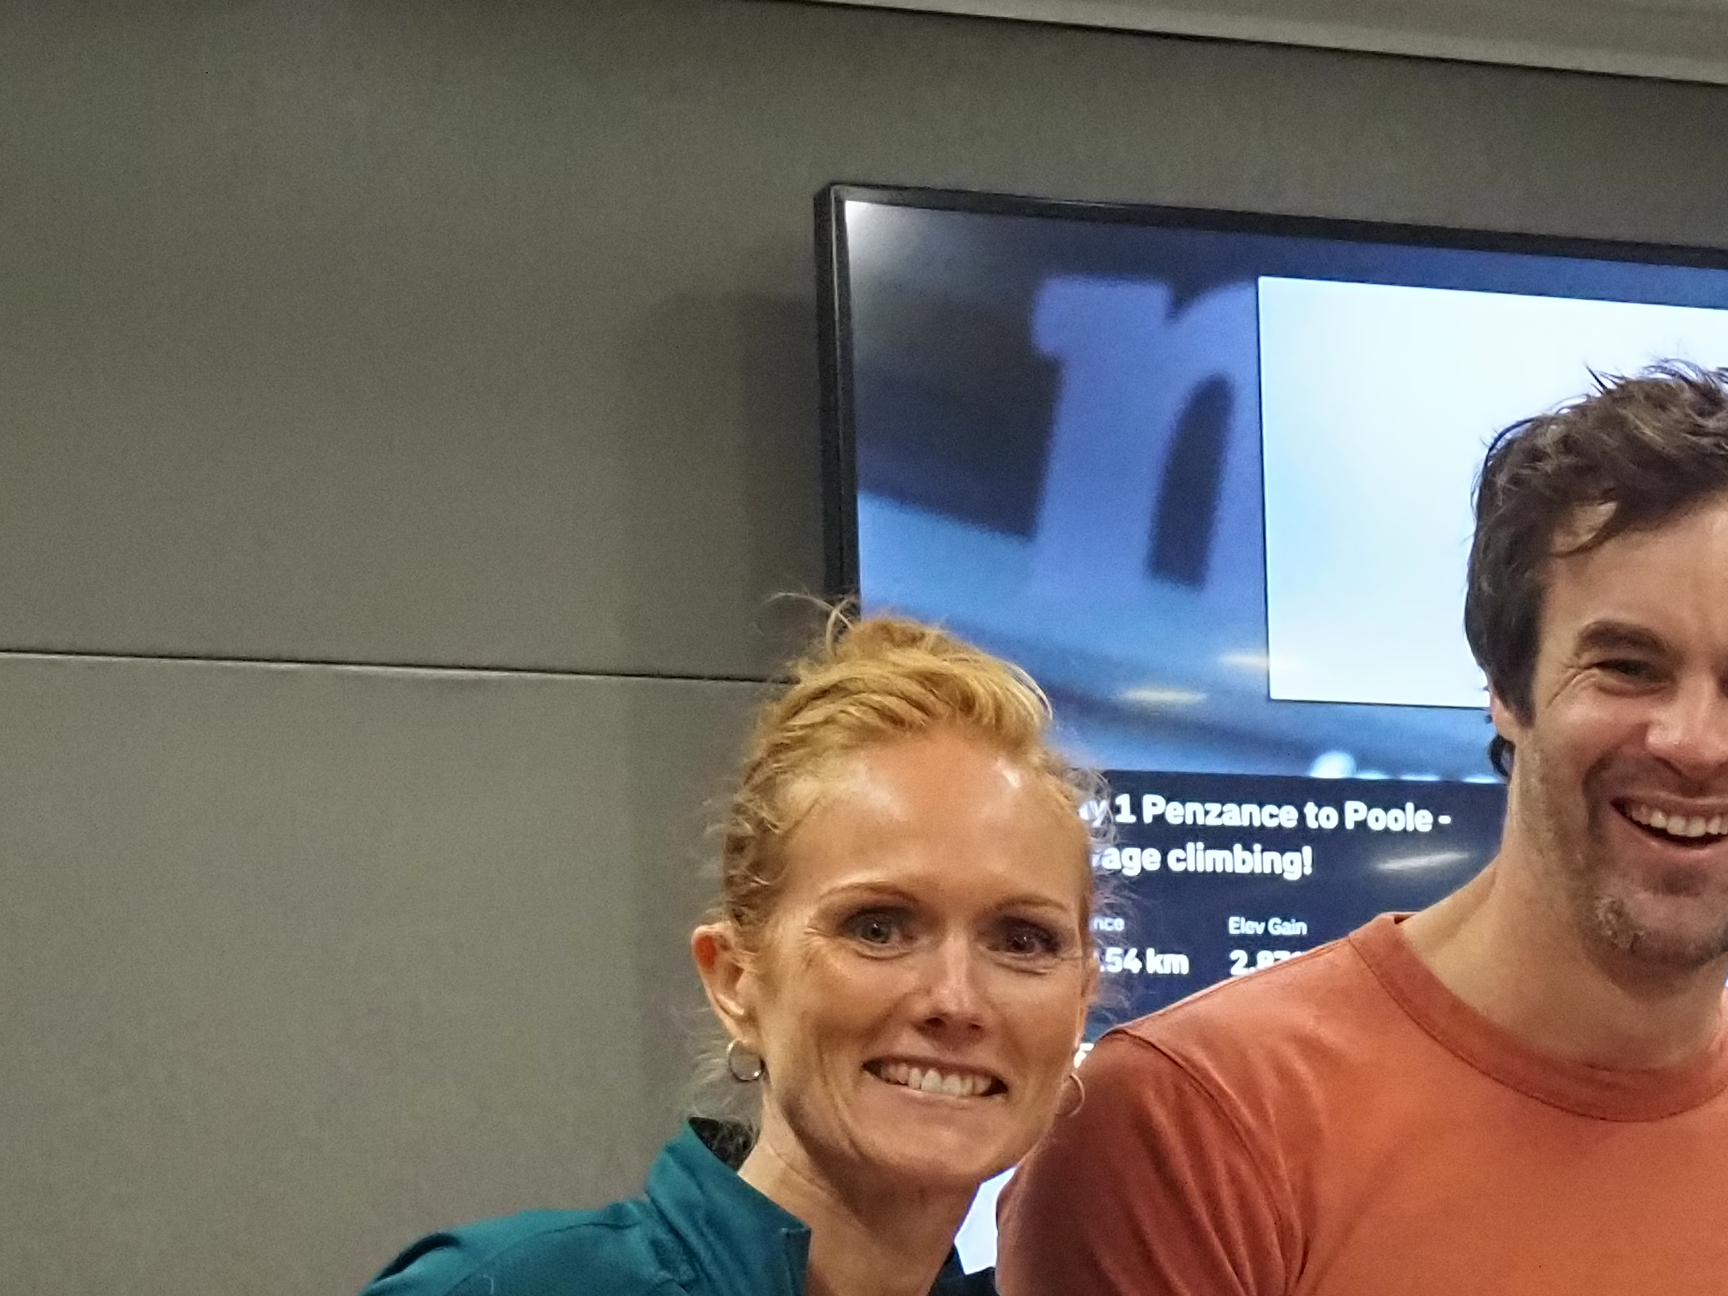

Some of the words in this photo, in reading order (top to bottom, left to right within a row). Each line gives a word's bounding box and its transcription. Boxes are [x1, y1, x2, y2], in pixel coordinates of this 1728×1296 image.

[1078, 799, 1110, 827] ay
[1115, 793, 1137, 823] 1
[1142, 793, 1299, 828] Penzance
[1304, 801, 1337, 830] to
[1344, 800, 1433, 832] Poole
[1167, 841, 1313, 881] climbing!
[1228, 916, 1265, 935] Elev
[1268, 917, 1308, 936] Gain
[1146, 948, 1190, 975] km
